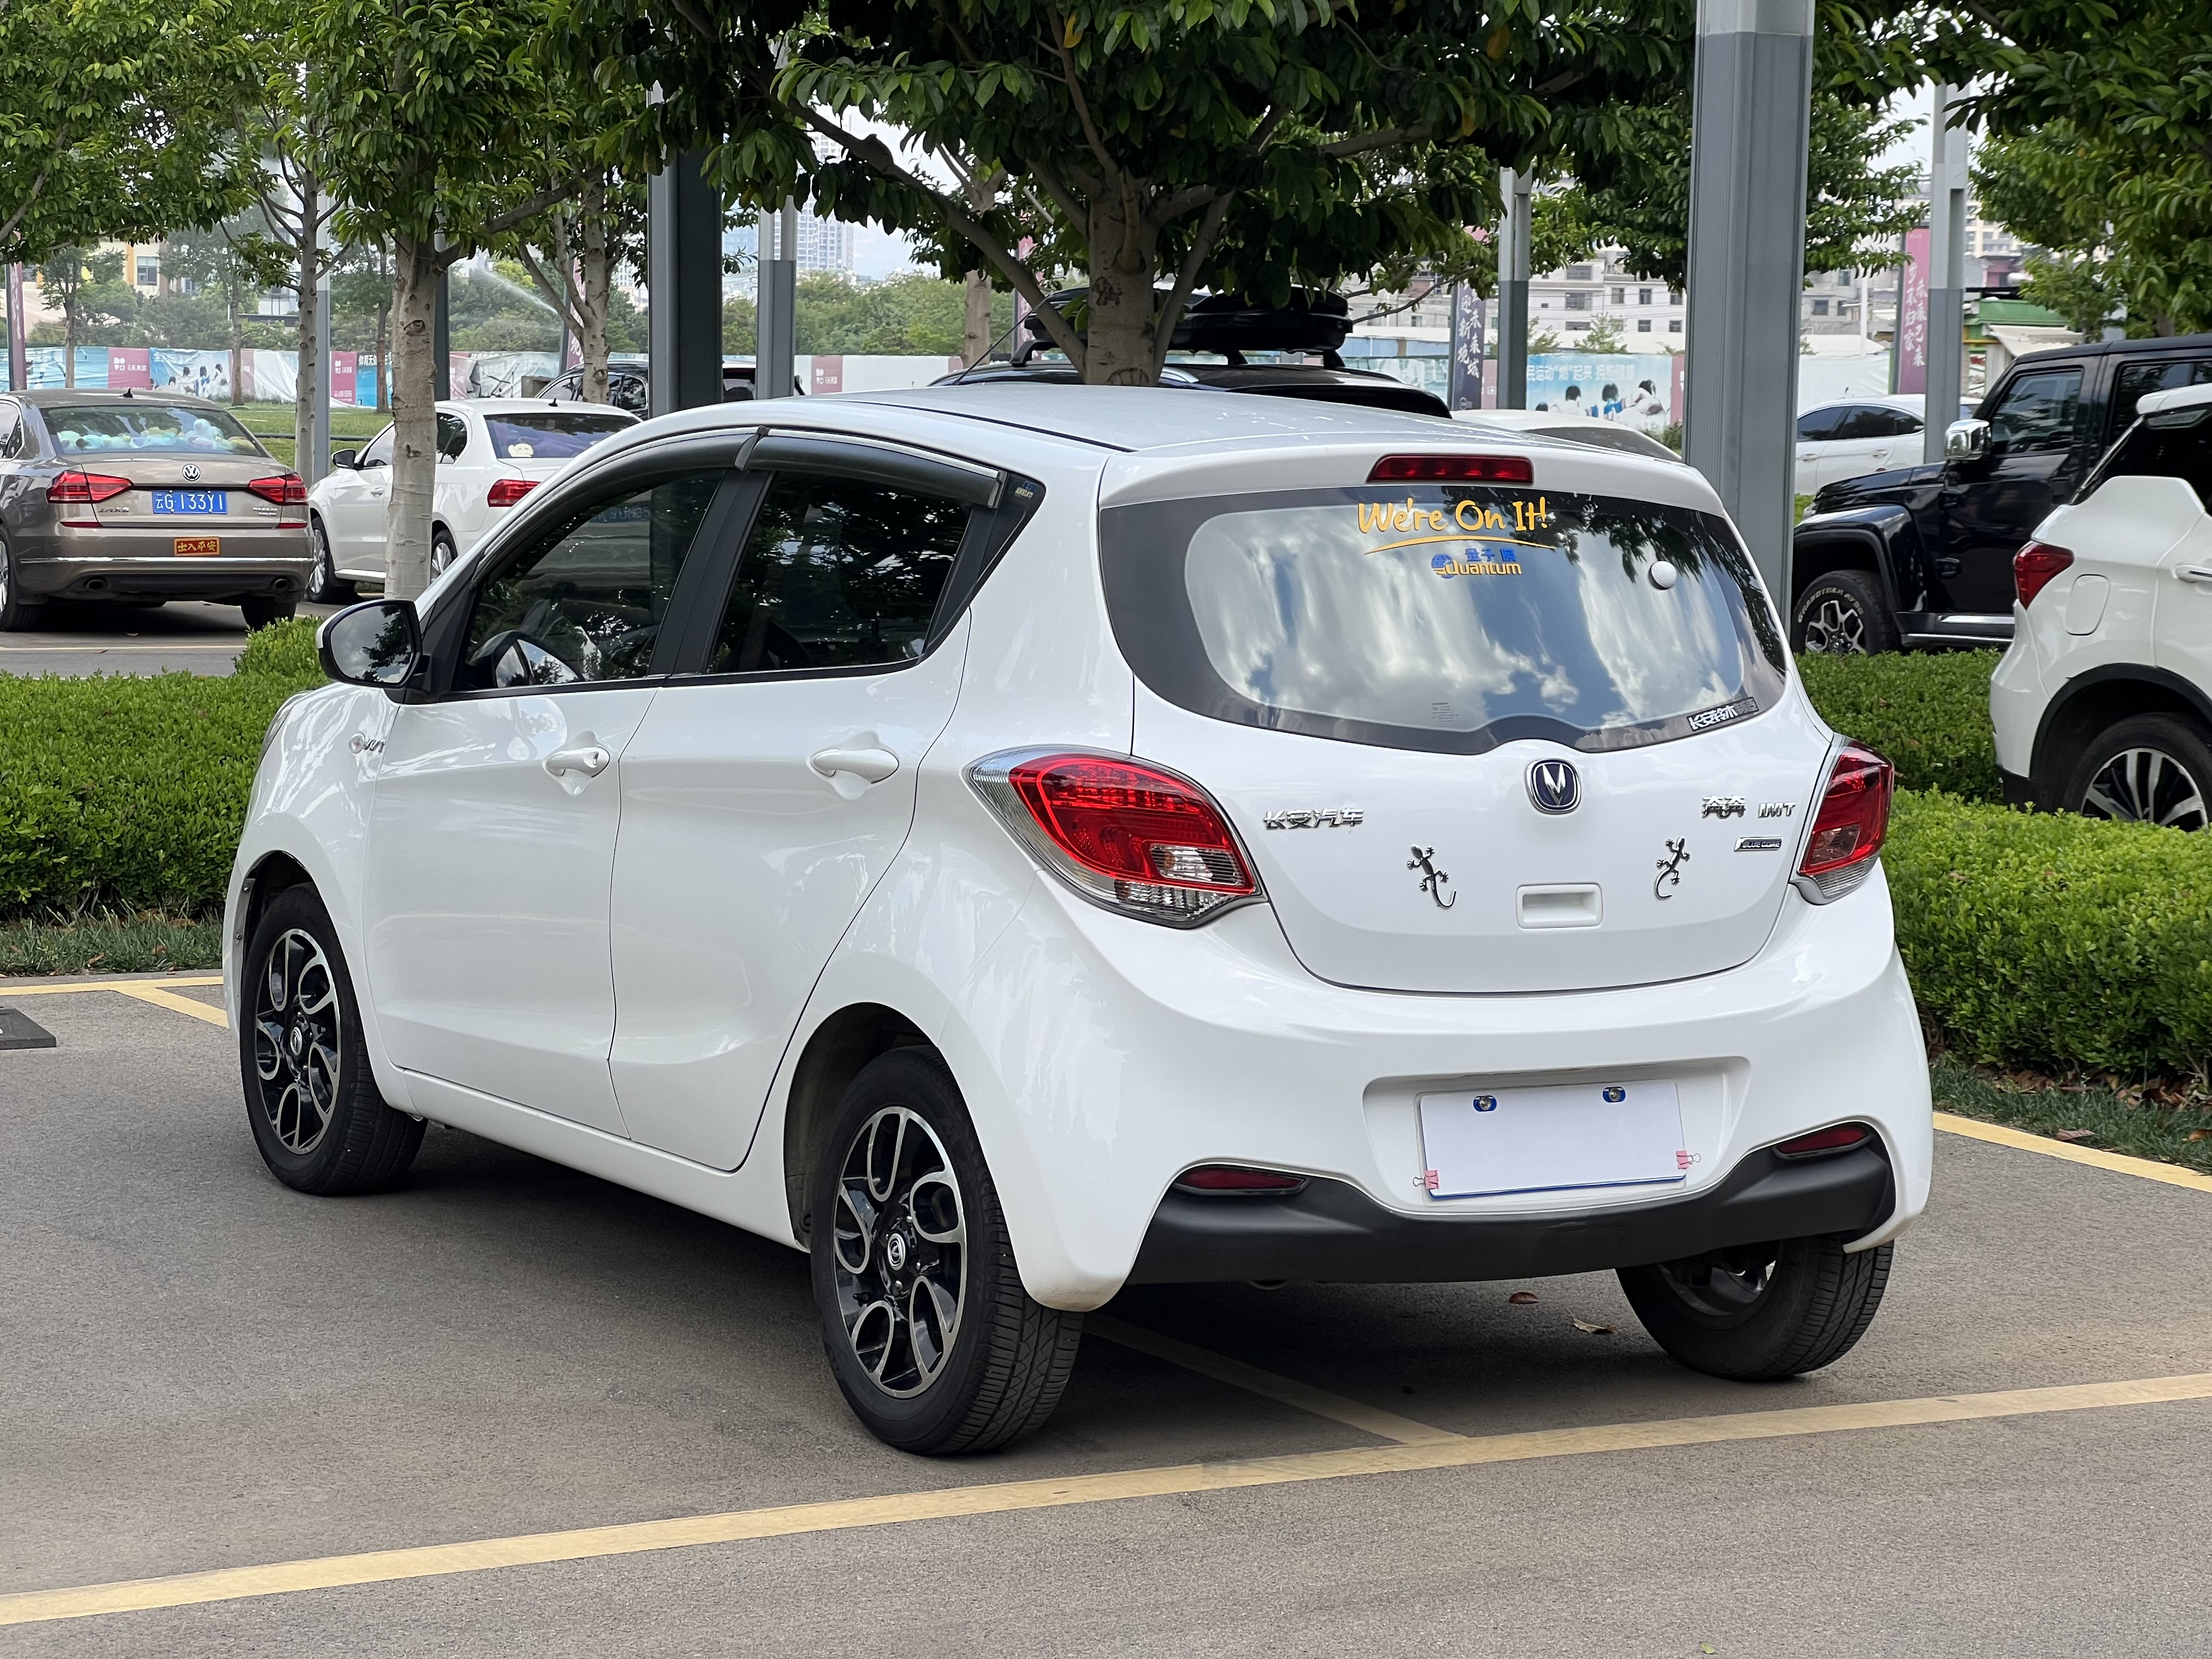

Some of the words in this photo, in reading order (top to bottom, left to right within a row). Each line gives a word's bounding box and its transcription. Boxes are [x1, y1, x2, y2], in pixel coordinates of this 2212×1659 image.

[1358, 498, 1448, 534] We're
[1455, 500, 1507, 532] On
[1512, 496, 1548, 532] It!
[177, 540, 217, 552] 出入平安
[1443, 559, 1522, 575] Quantum
[1702, 795, 1746, 820] 奔奔
[1758, 802, 1797, 818] IMT
[1263, 808, 1364, 830] 长安汽车
